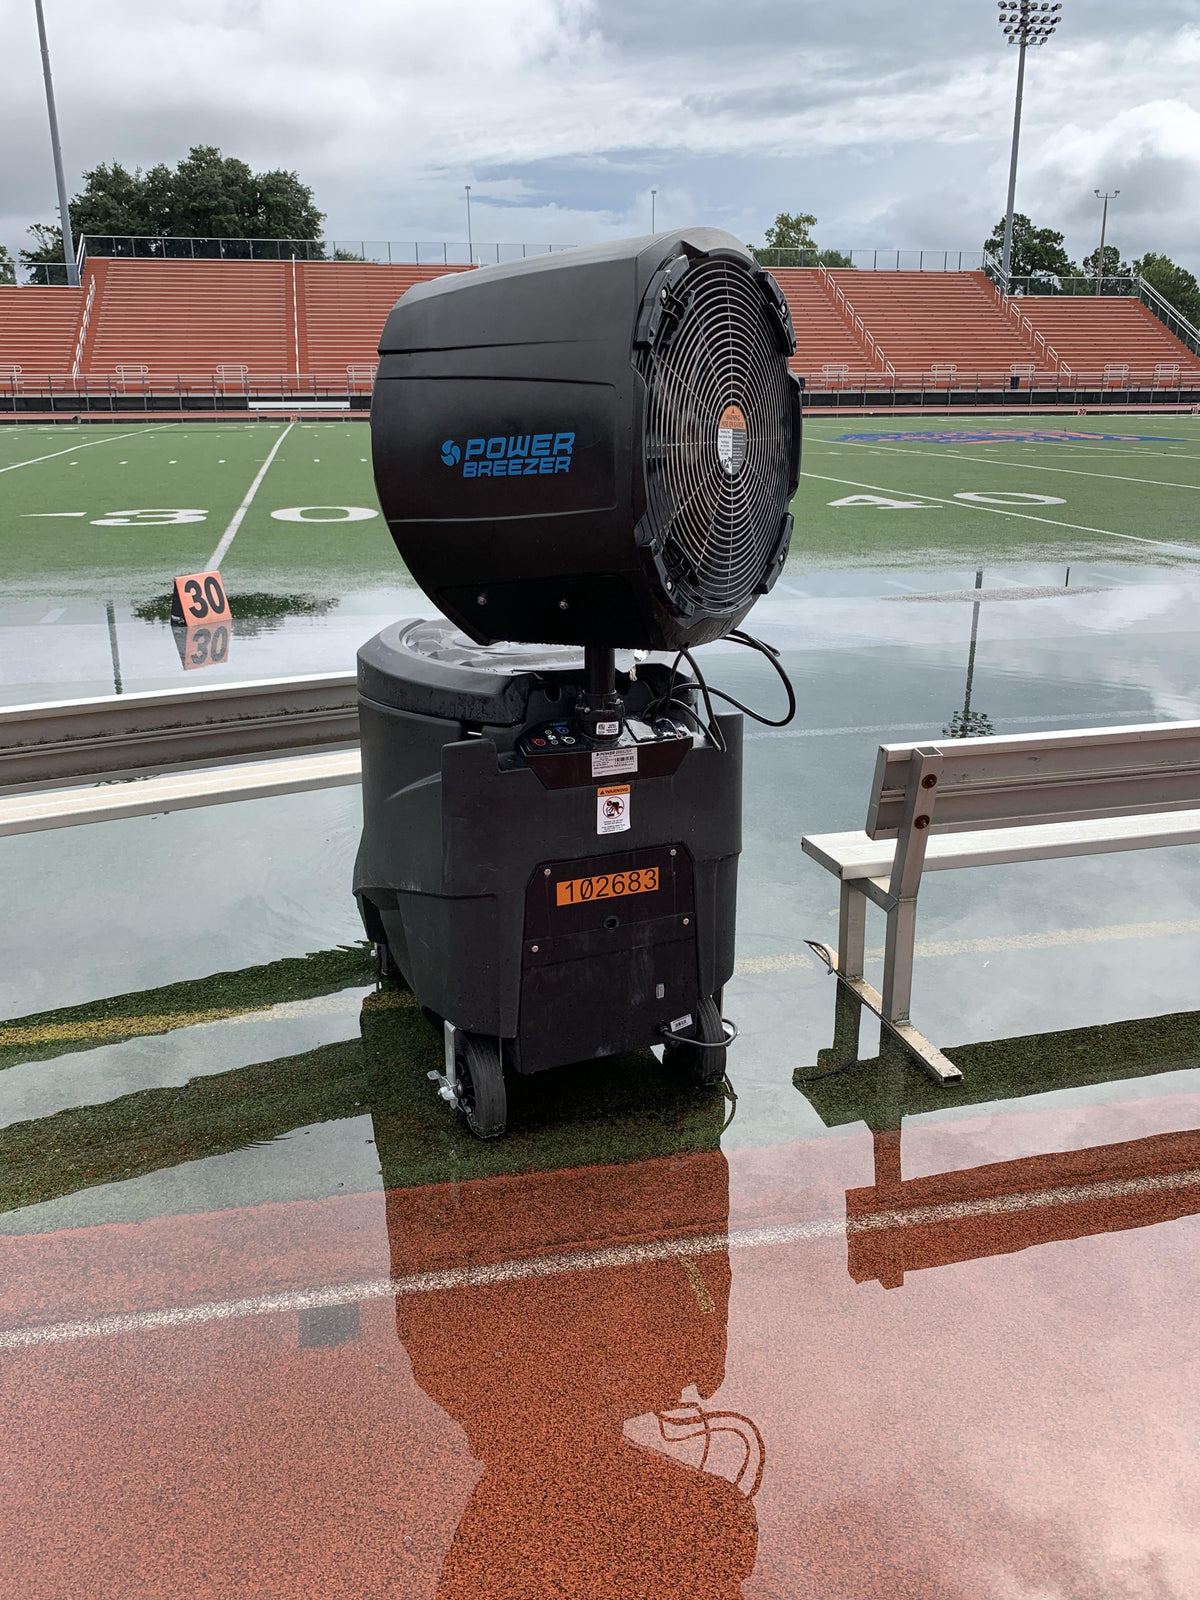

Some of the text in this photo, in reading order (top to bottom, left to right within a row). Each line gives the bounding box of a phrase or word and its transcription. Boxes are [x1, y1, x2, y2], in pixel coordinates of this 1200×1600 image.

[465, 432, 575, 460] POWER
[463, 456, 571, 478] BREEZER
[184, 576, 226, 619] 30
[565, 869, 657, 902] 102683
